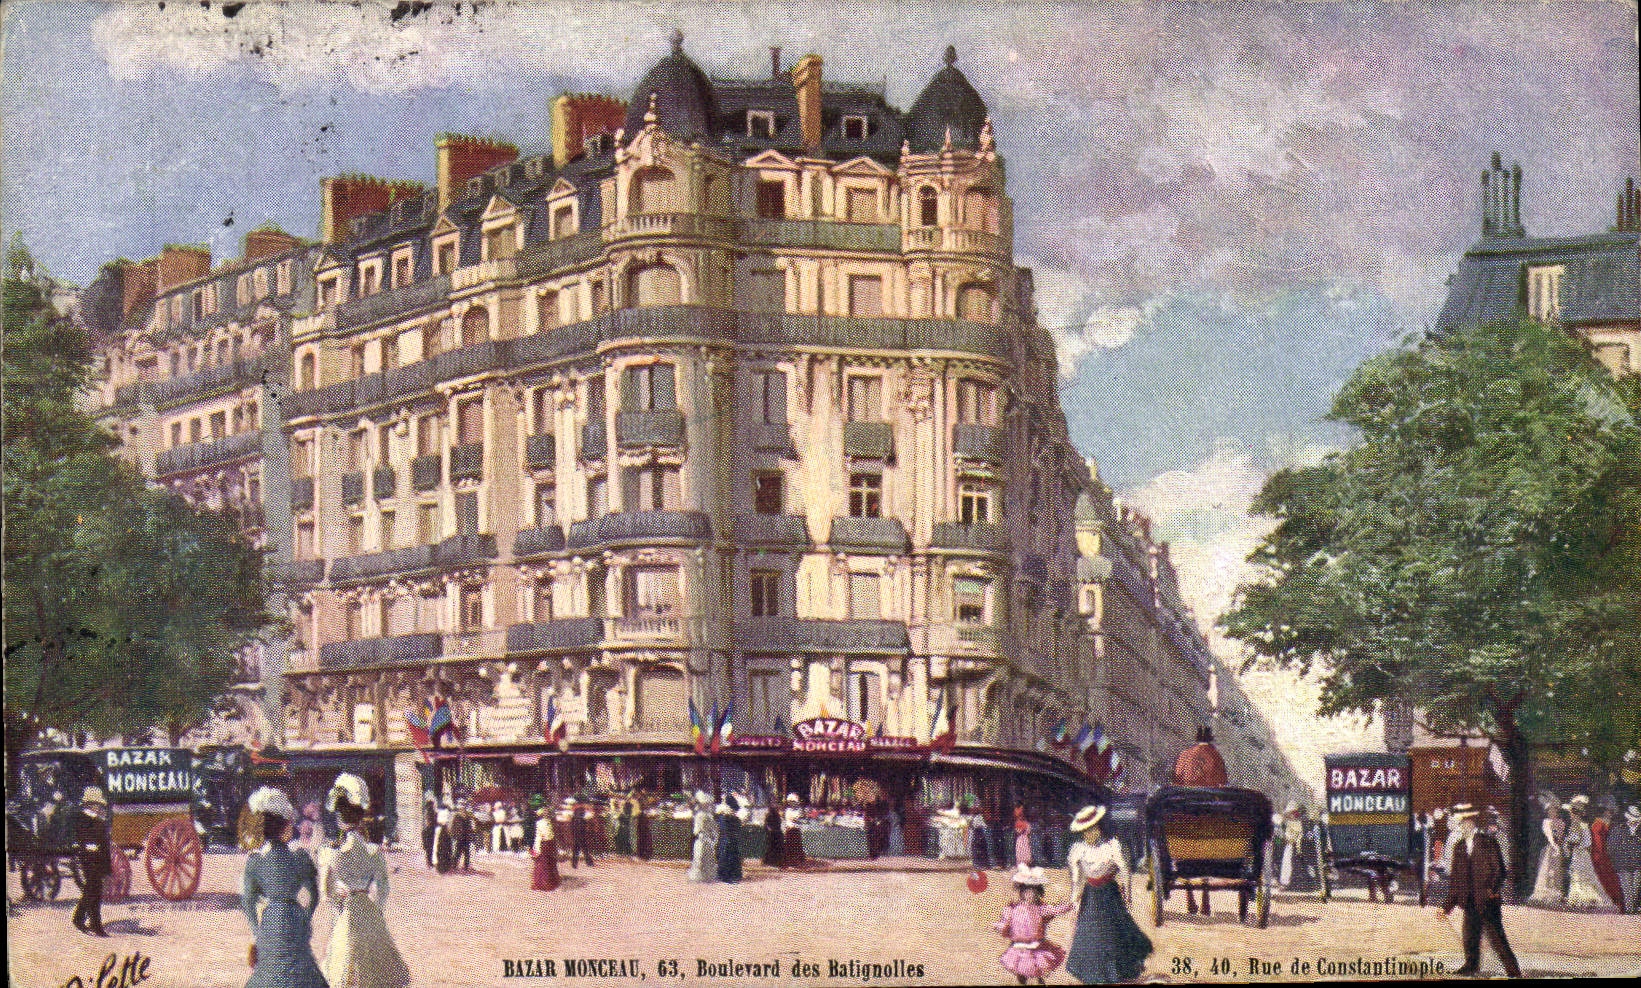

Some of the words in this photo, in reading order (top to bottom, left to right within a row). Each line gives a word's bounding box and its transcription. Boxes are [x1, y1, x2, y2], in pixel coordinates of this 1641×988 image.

[797, 719, 864, 739] BAZAR
[793, 738, 866, 752] MONCEAU
[106, 750, 172, 768] BAZAR
[107, 771, 190, 793] MONCEAU
[1330, 768, 1402, 789] BAZAR
[1330, 795, 1407, 813] MONCEAU
